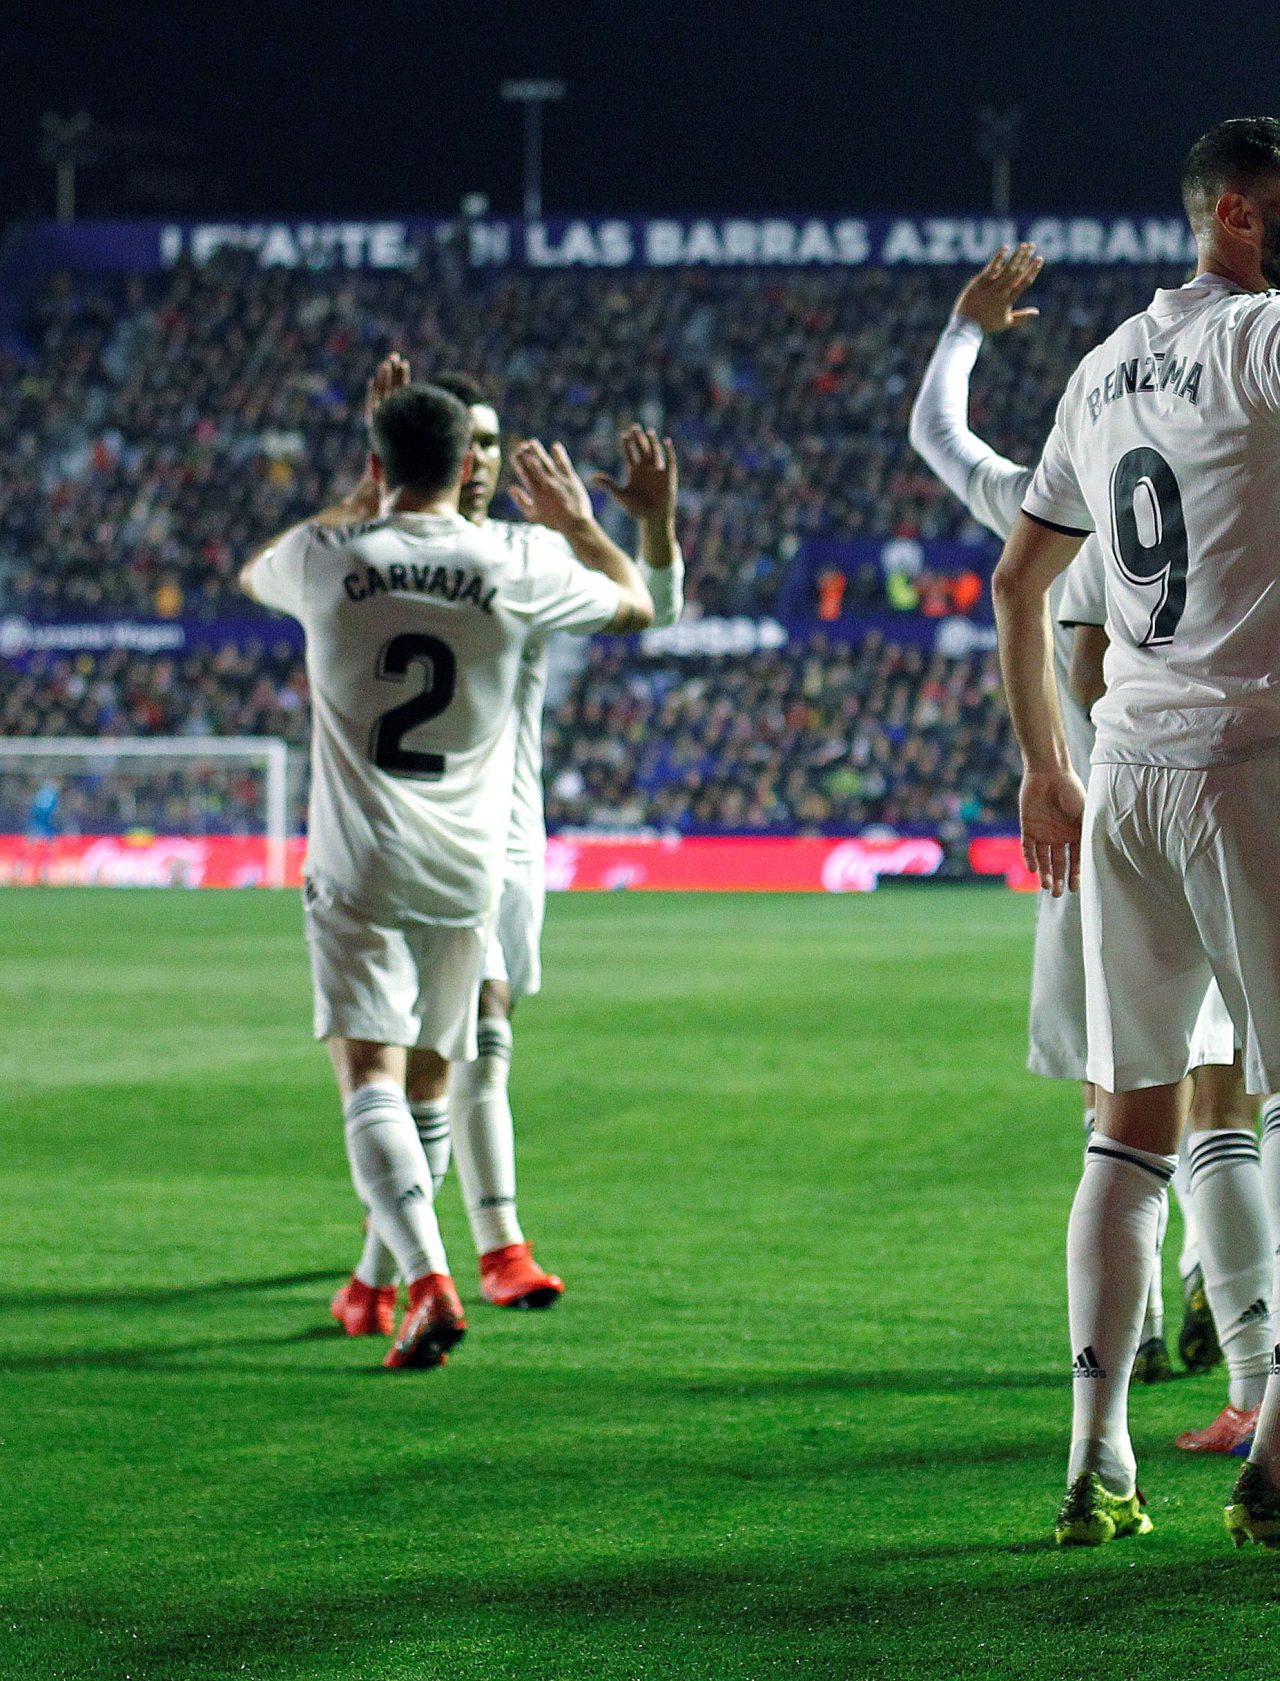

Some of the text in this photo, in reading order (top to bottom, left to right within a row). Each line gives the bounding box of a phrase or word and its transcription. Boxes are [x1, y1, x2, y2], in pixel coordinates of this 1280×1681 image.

[524, 219, 634, 267] LAS
[645, 219, 870, 266] BARRAS
[884, 218, 1199, 264] AZULGRAN
[343, 563, 498, 614] CARVAJAL
[1110, 447, 1189, 647] 9
[372, 634, 457, 782] 2
